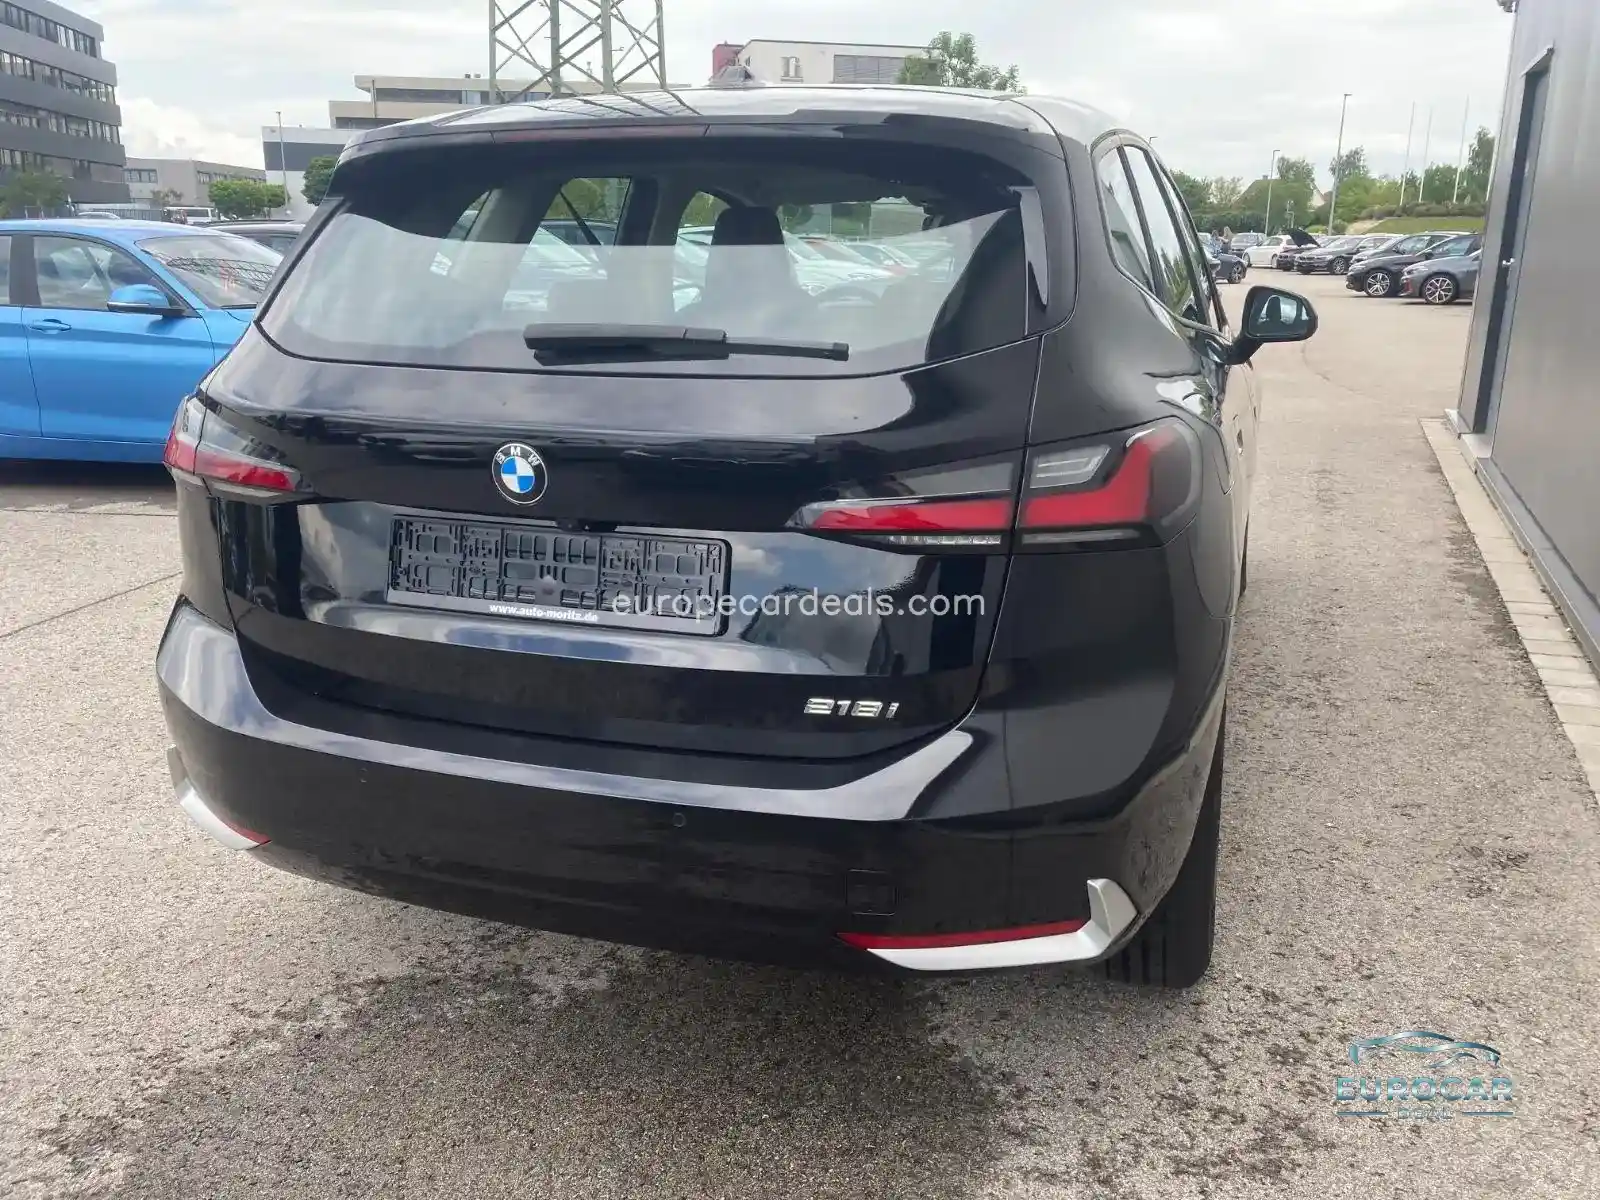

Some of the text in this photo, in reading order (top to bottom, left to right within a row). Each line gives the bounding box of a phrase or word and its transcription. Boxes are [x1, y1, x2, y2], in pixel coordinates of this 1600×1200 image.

[495, 445, 541, 466] BMW
[489, 604, 598, 622] www.auto-moritz.de
[803, 697, 900, 719] 218i
